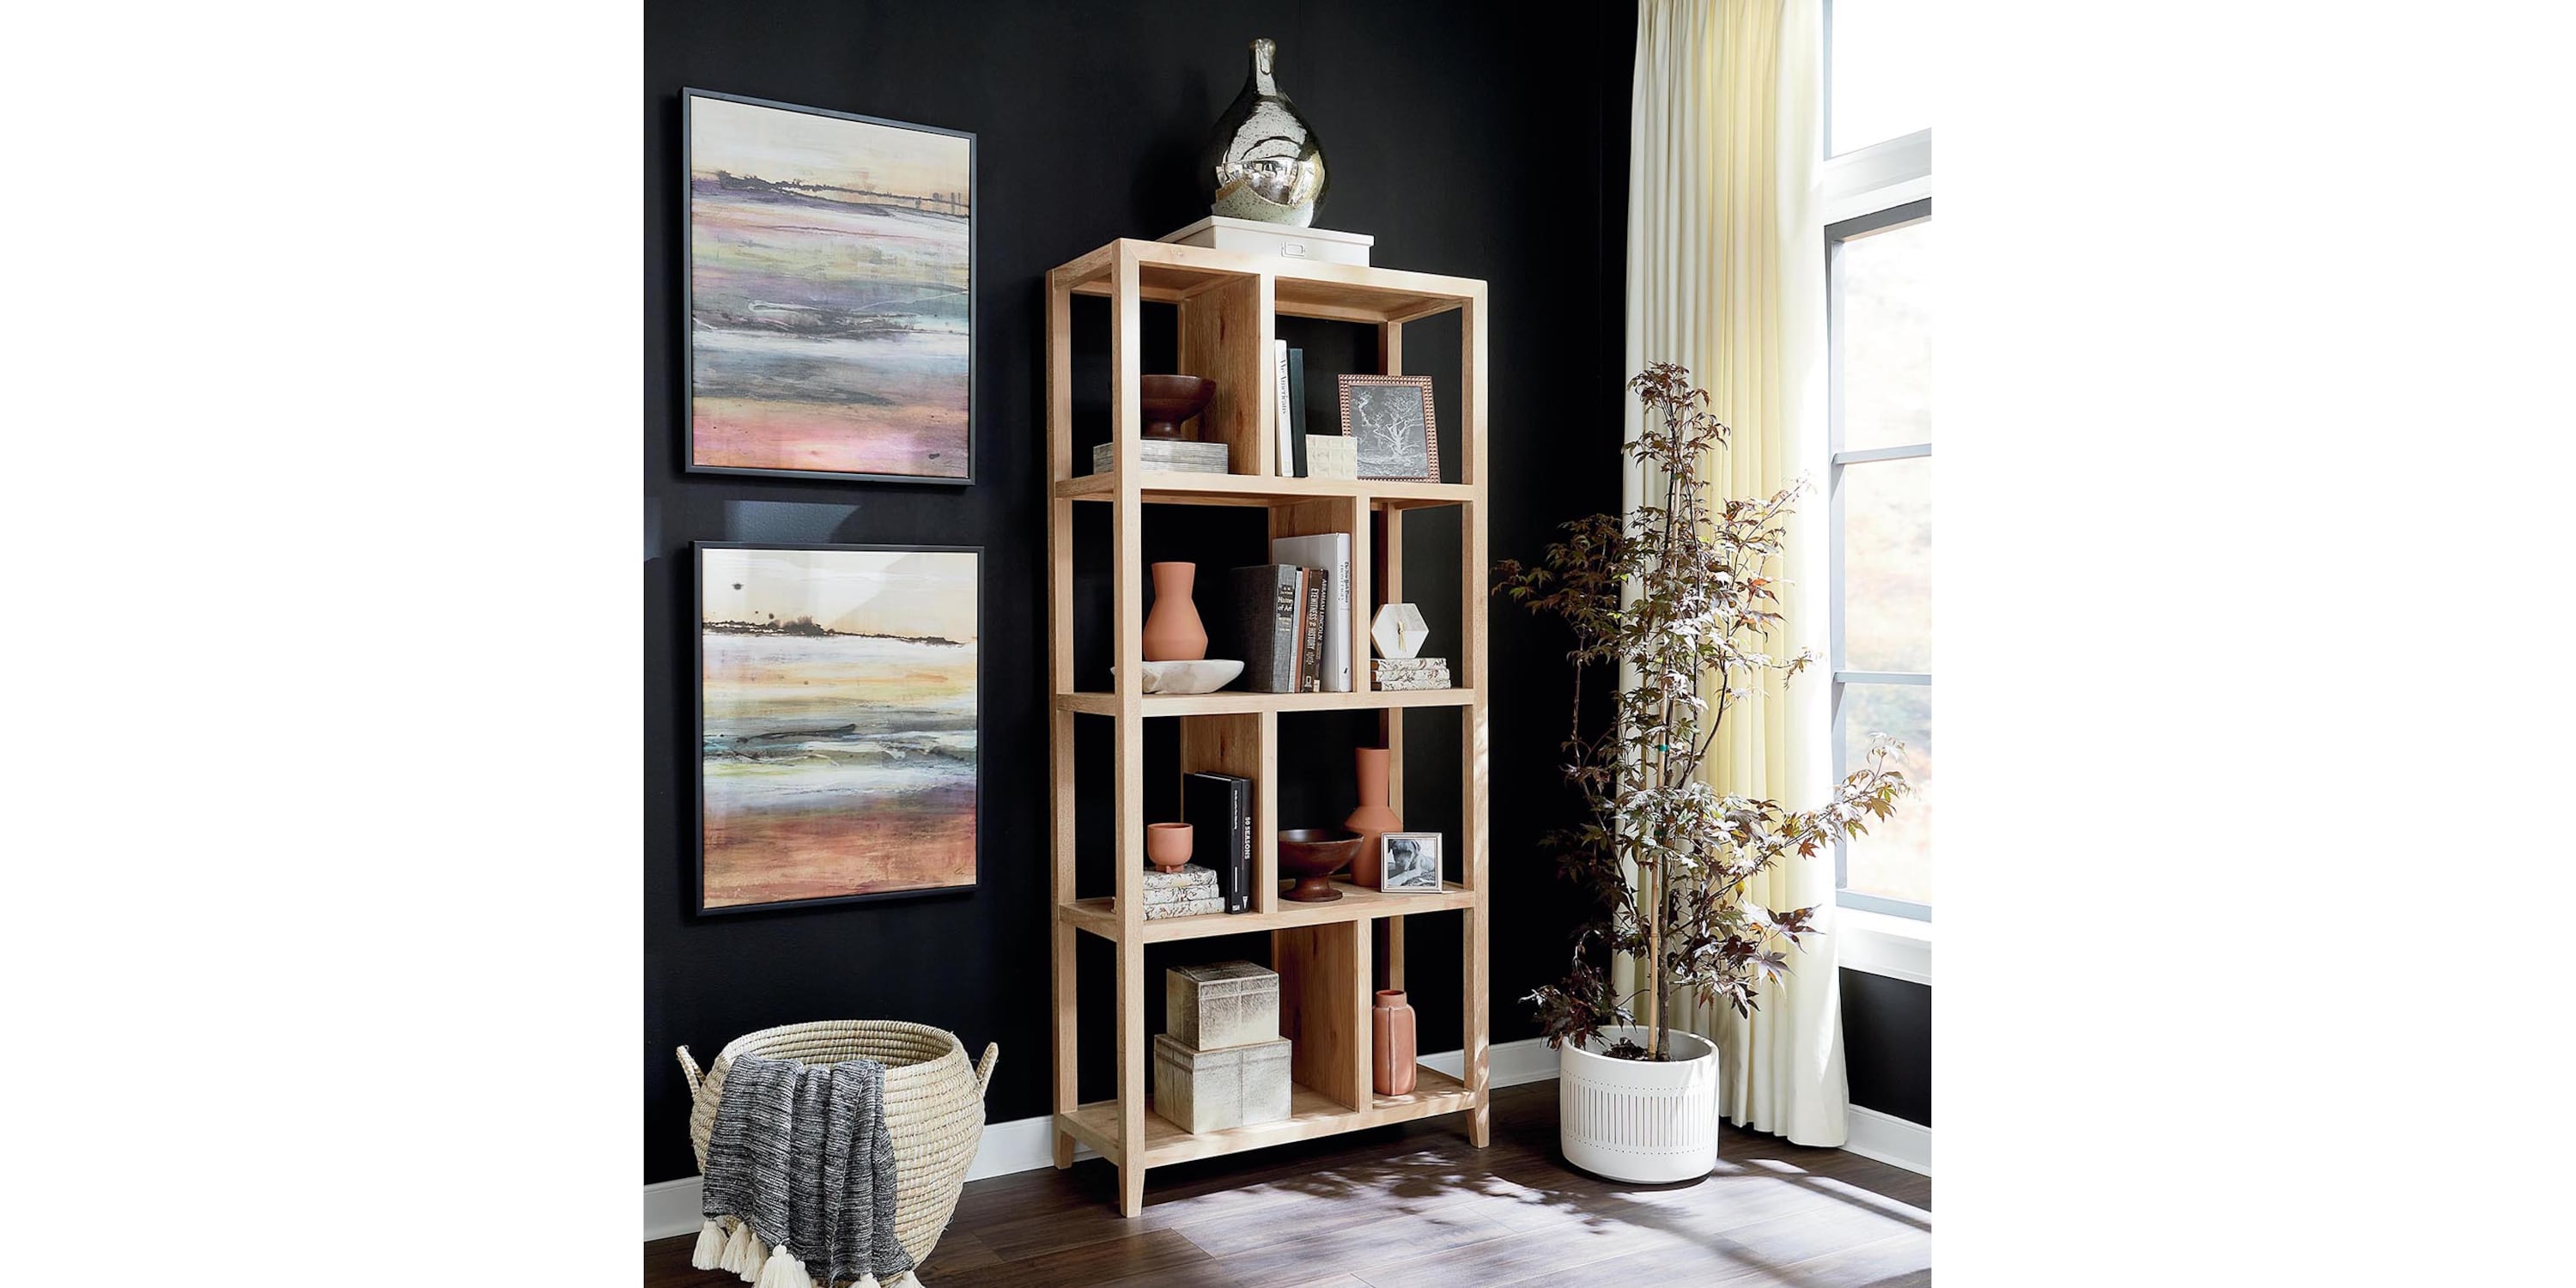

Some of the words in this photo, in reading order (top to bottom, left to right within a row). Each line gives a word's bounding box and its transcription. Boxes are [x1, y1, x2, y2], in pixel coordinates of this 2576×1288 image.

[1309, 587, 1319, 621] EYEWITNESS
[1307, 628, 1316, 650] HISTORY
[1244, 817, 1251, 825] 50
